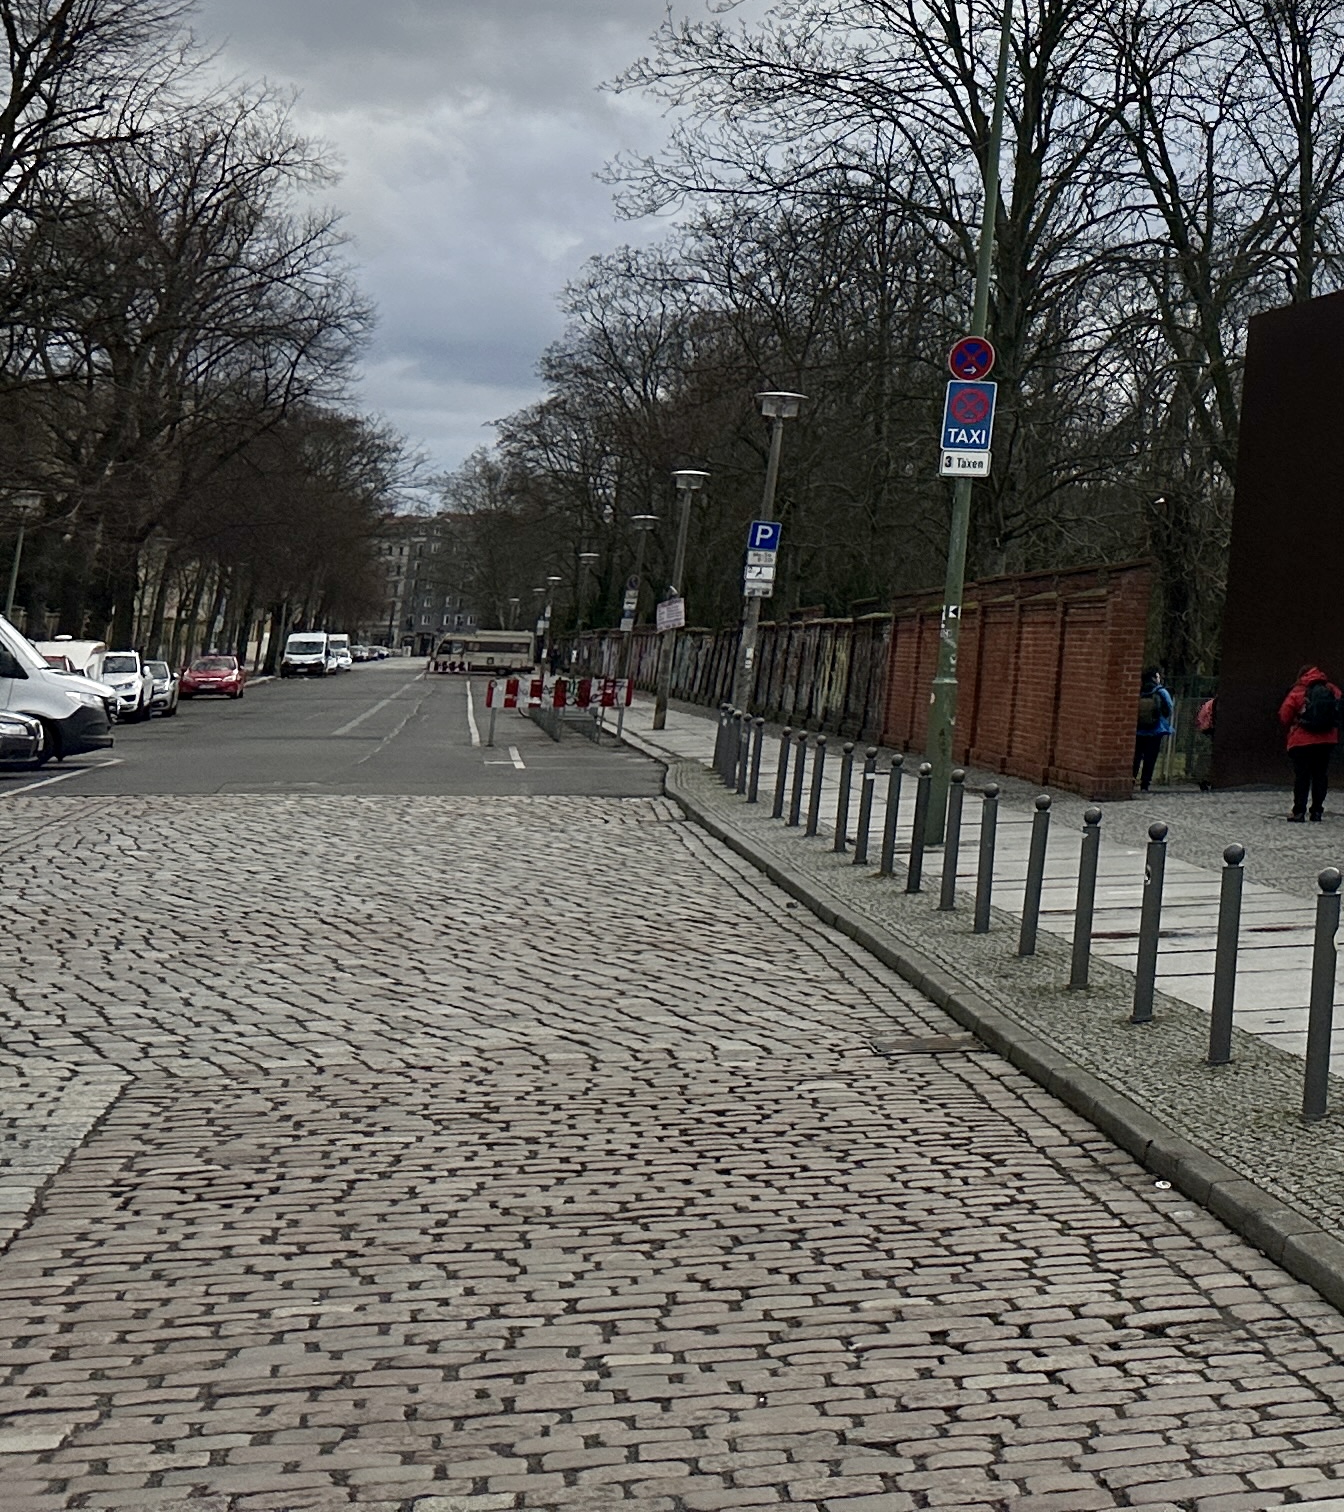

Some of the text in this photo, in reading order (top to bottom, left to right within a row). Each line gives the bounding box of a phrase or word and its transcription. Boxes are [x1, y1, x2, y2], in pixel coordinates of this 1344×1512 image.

[947, 428, 986, 444] TAXI
[944, 455, 984, 469] 3 Taxen
[755, 525, 773, 546] P
